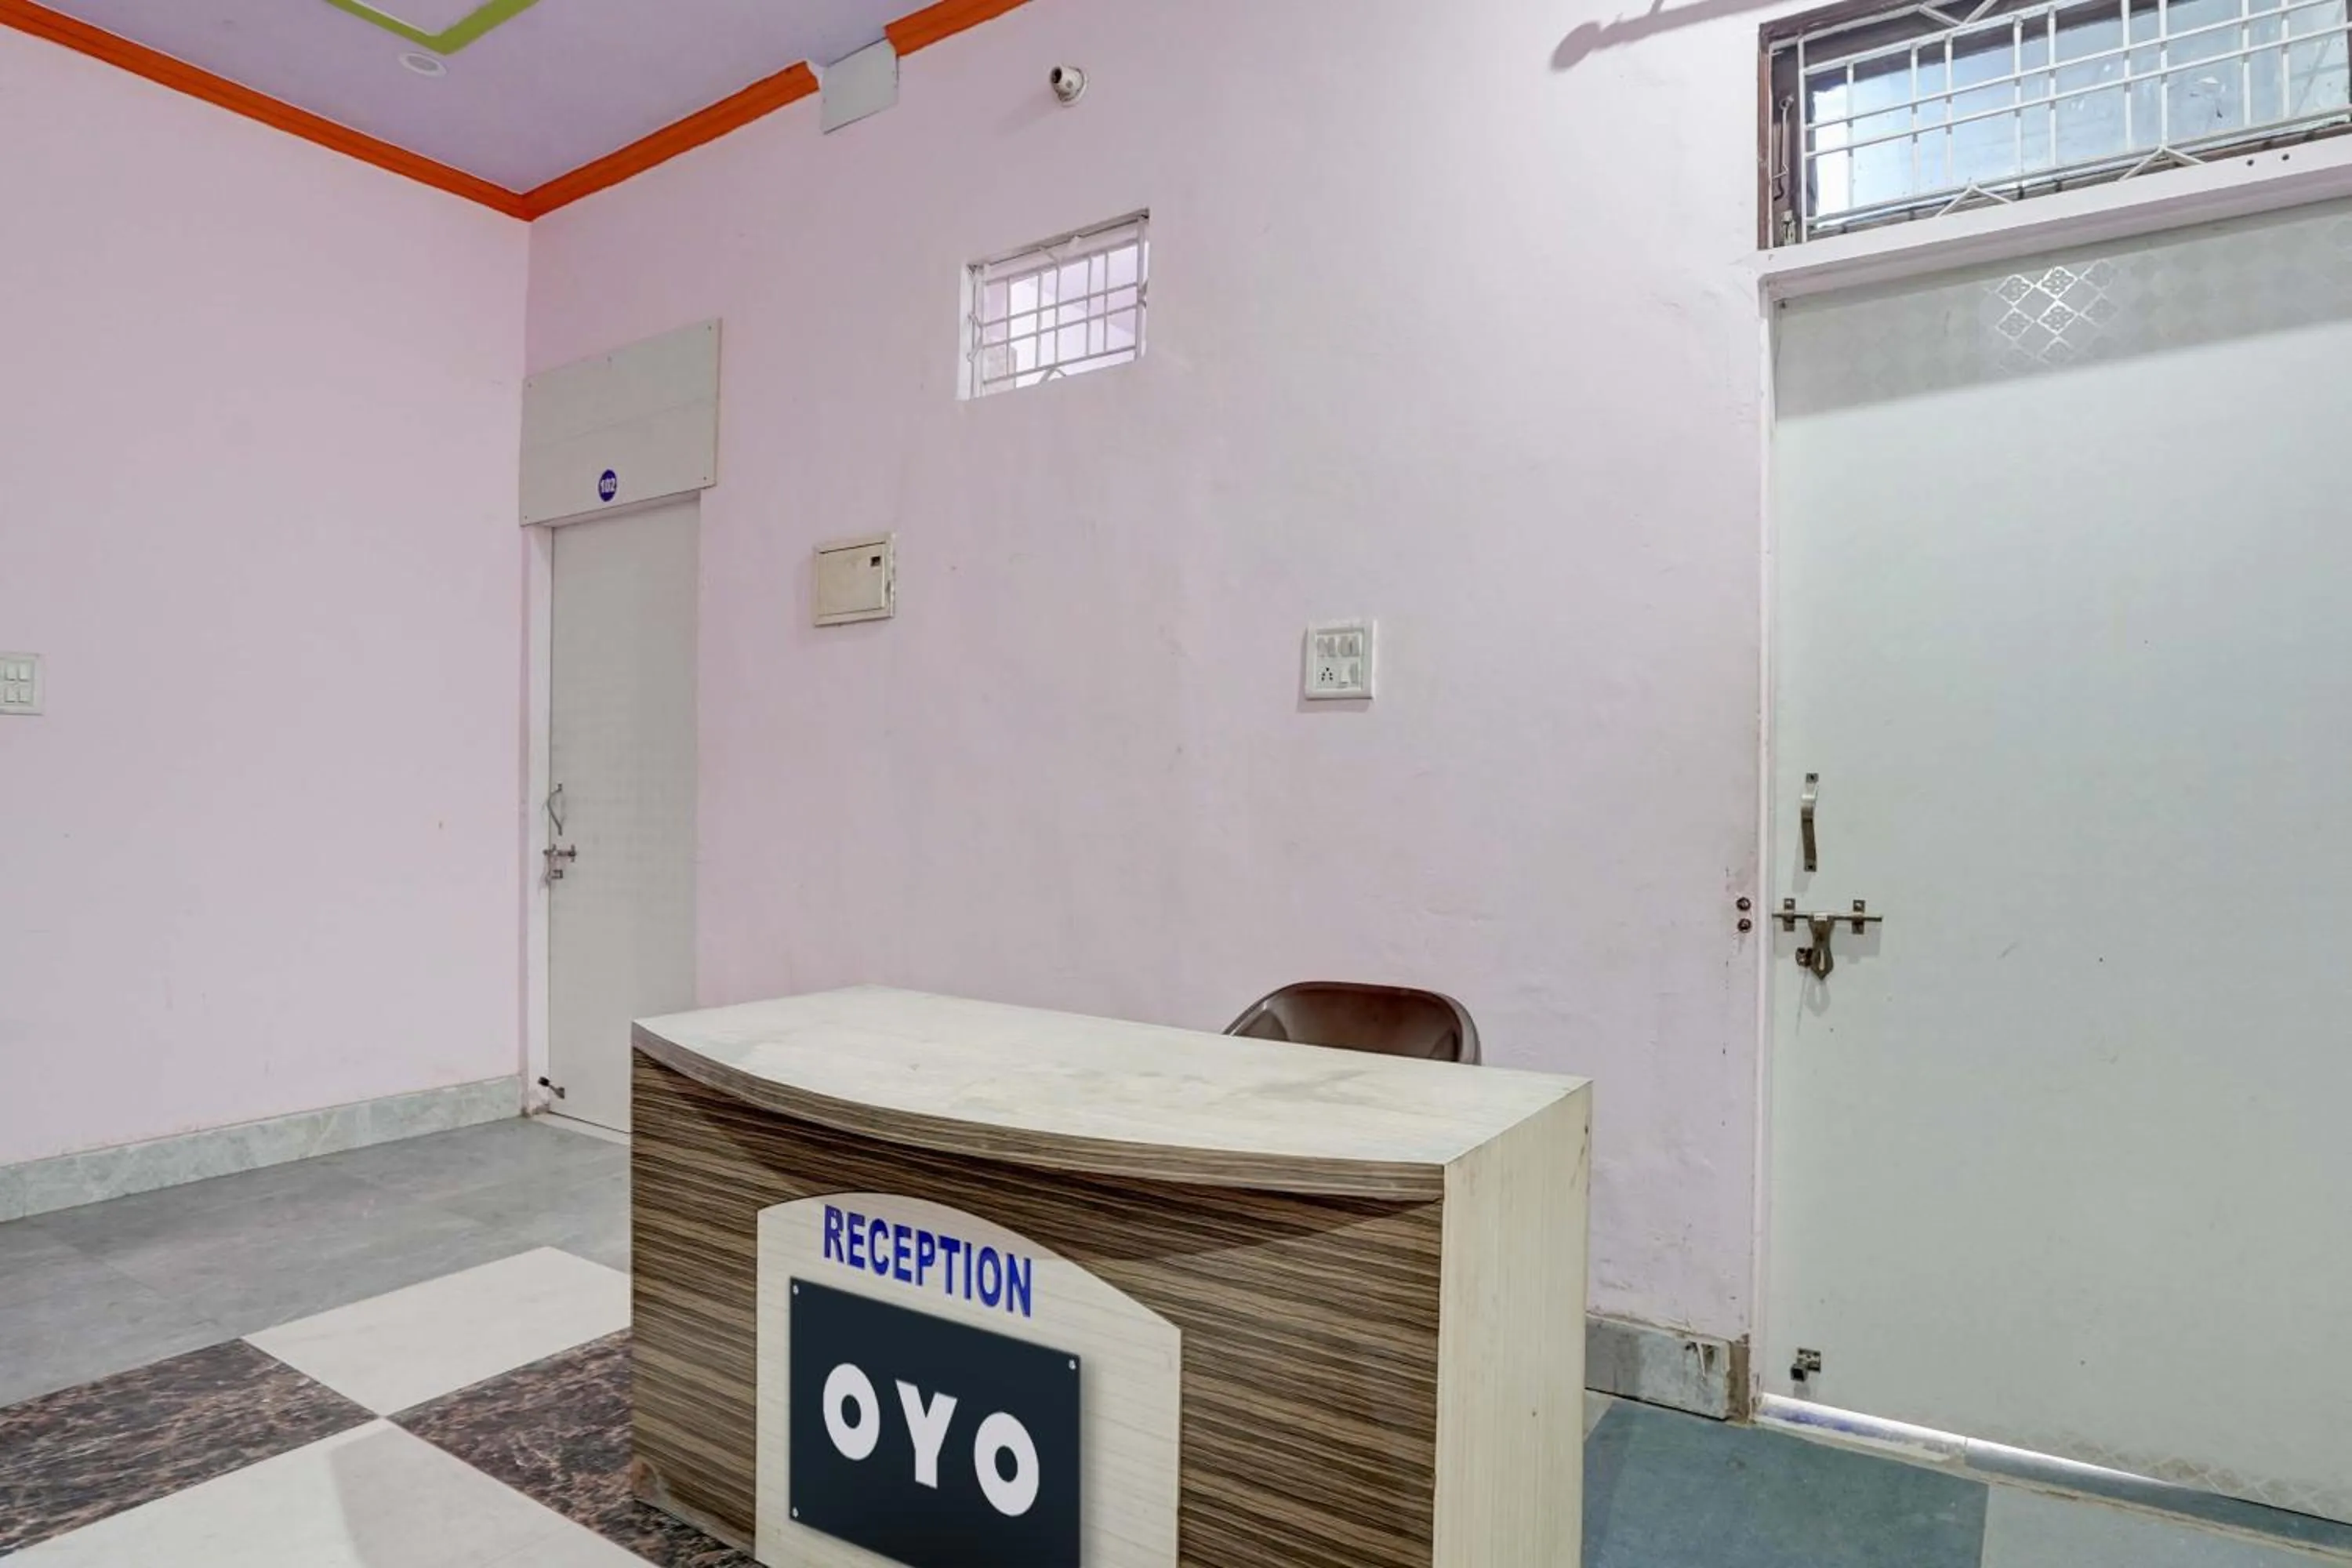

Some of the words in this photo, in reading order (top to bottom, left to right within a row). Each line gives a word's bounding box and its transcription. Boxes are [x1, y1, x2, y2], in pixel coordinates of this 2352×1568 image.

[601, 478, 615, 492] 102
[824, 1204, 1031, 1317] RECEPTION
[822, 1363, 1040, 1517] OYO
